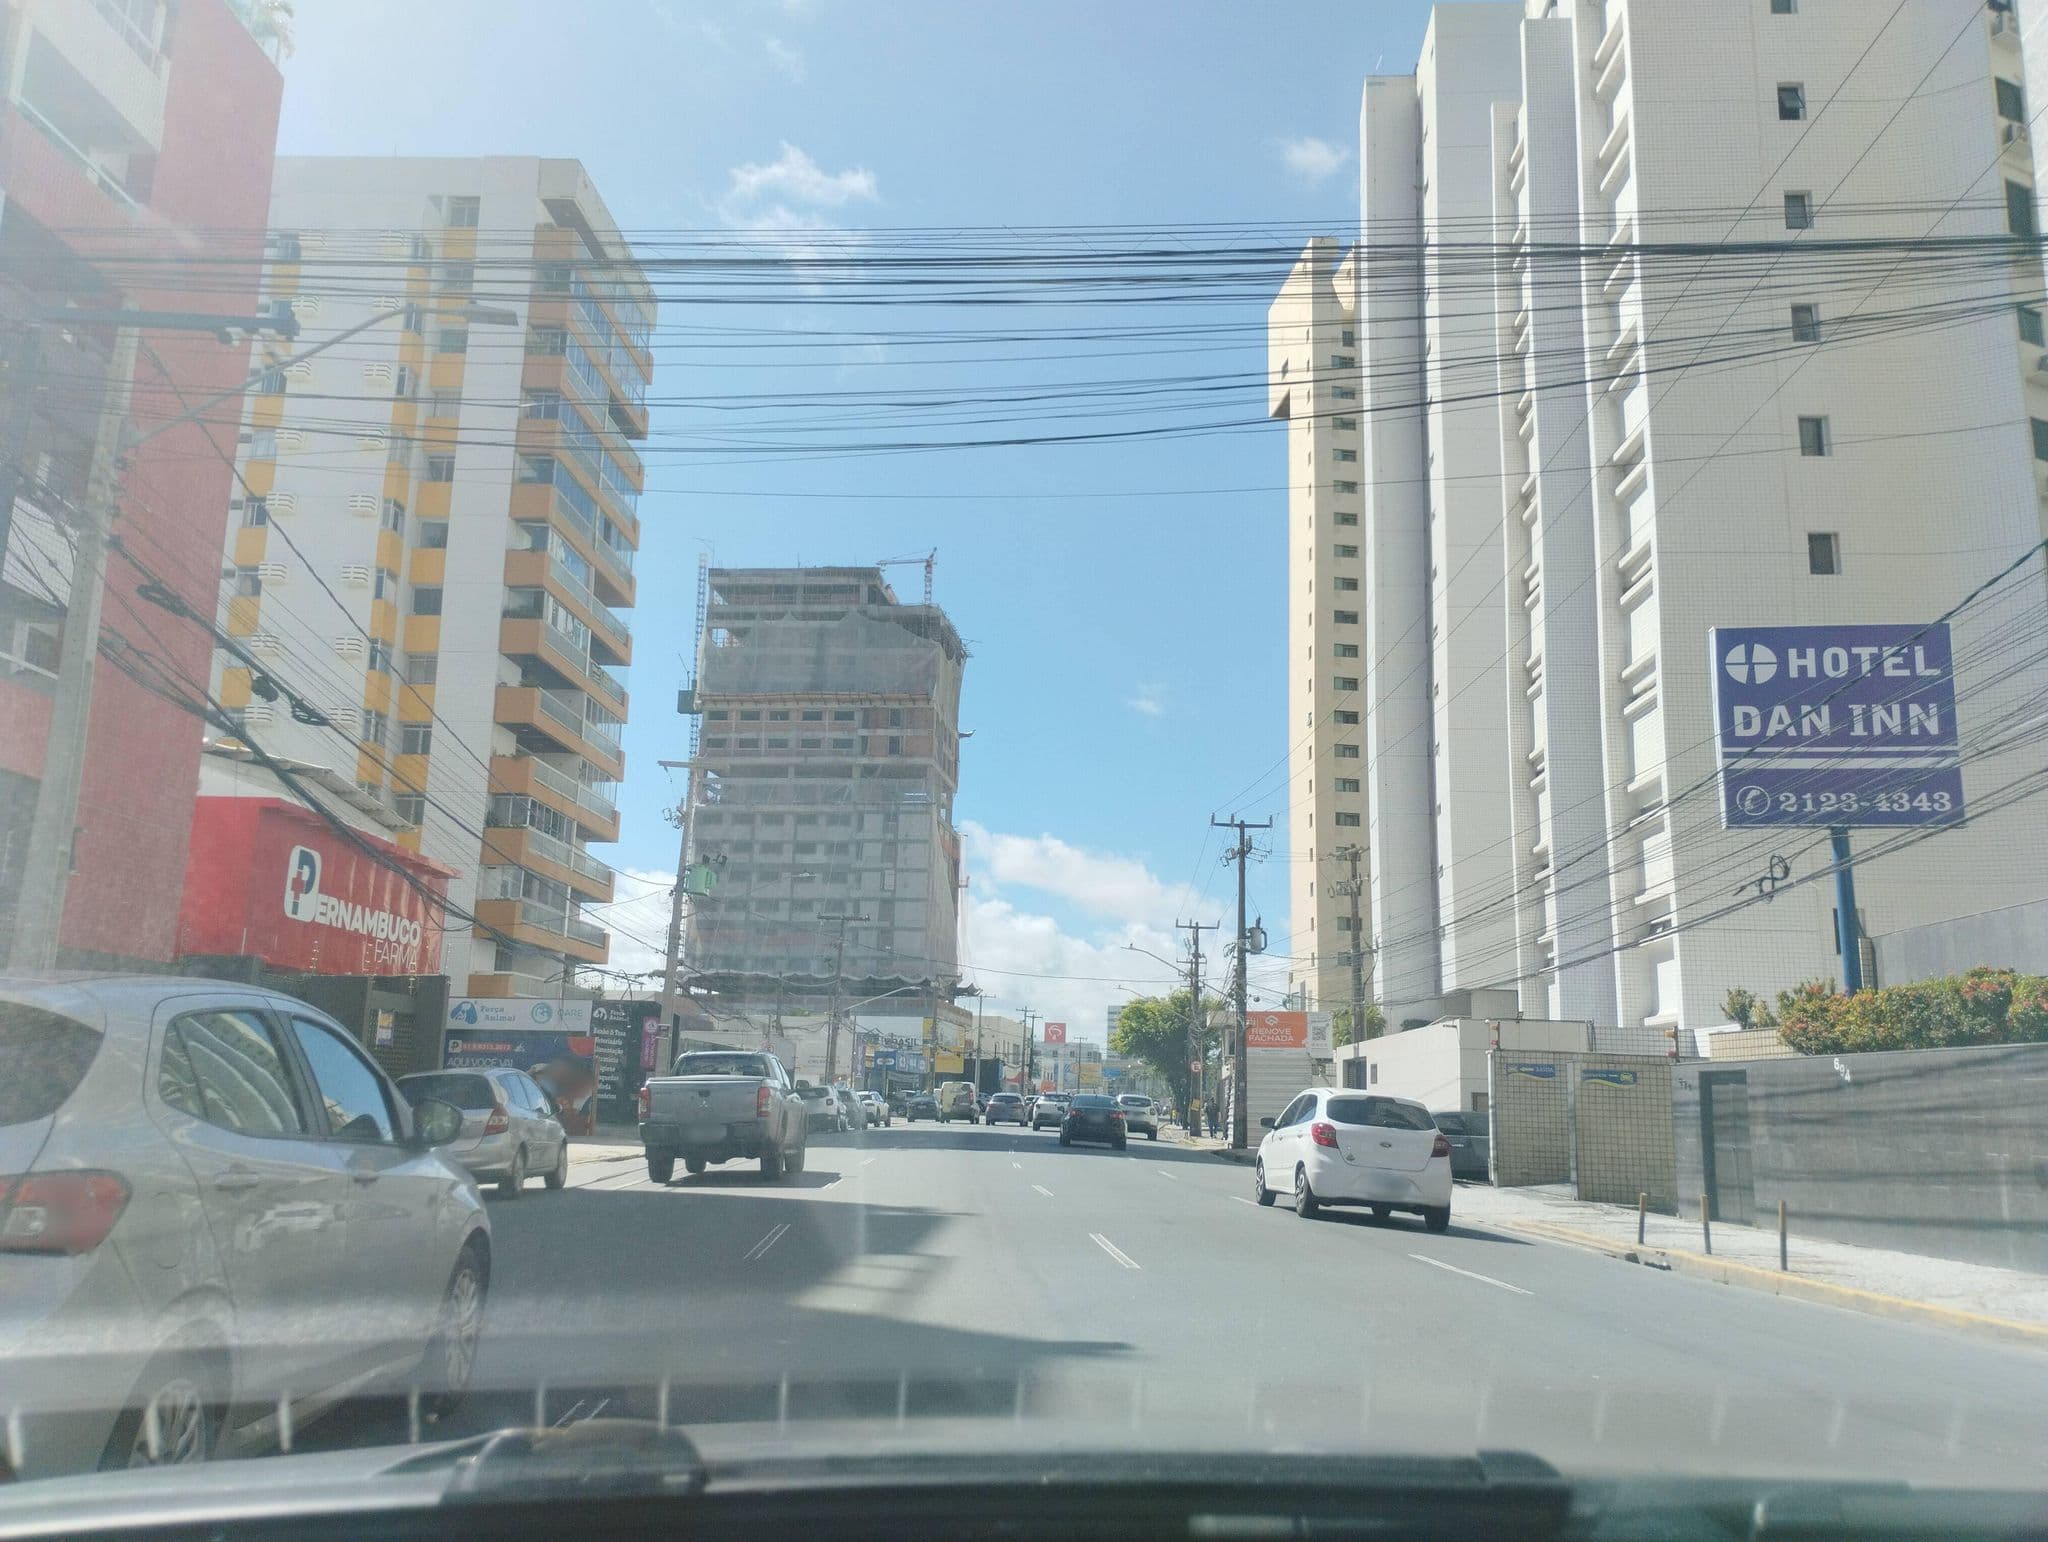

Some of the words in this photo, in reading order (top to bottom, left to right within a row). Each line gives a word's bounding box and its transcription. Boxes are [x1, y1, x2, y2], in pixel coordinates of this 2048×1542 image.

[1788, 645, 1941, 678] HOTEL
[1733, 705, 1831, 737] DAN
[1848, 703, 1940, 736] INN
[1779, 791, 1952, 812] 2123-4343
[284, 845, 421, 947] PERNAMBUCO
[374, 939, 418, 972] FARMA
[1833, 1057, 1851, 1083] 694
